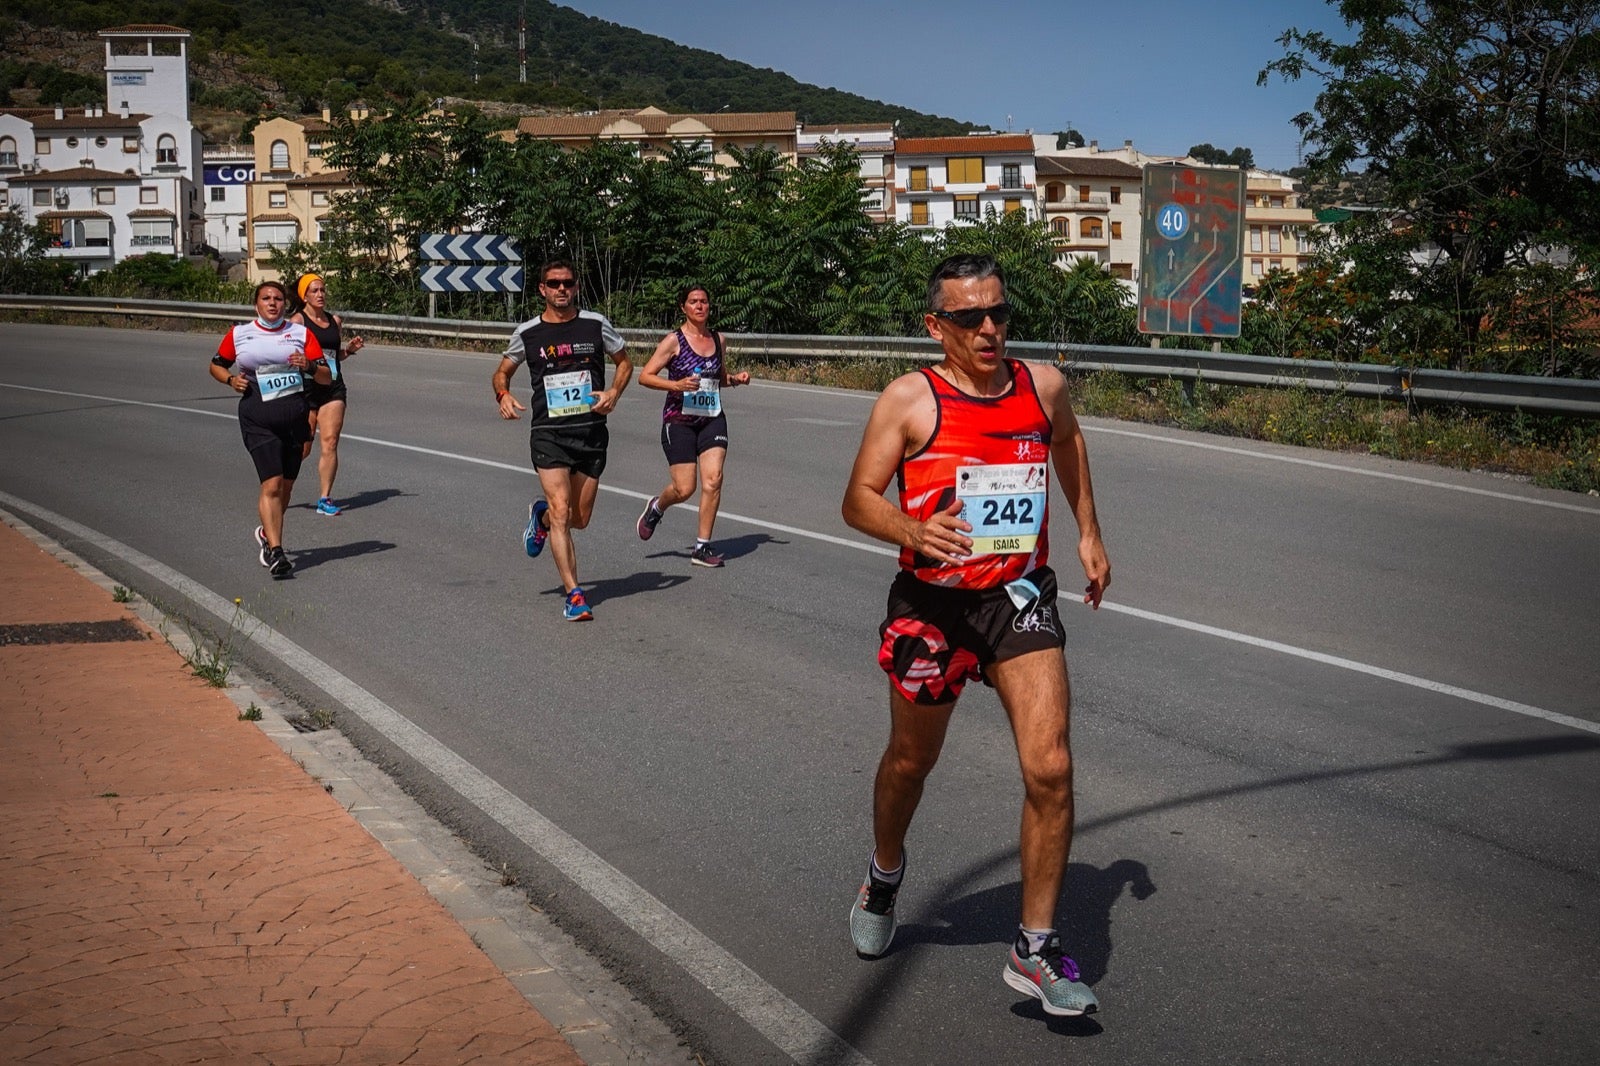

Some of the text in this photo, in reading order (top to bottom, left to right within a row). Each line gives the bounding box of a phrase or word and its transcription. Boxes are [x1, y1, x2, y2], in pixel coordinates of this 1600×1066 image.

[1162, 210, 1183, 232] 40
[267, 375, 296, 390] 1070
[563, 388, 581, 402] 12
[691, 395, 715, 406] 1008
[983, 498, 1034, 525] 242
[993, 538, 1020, 551] ISAIAS
